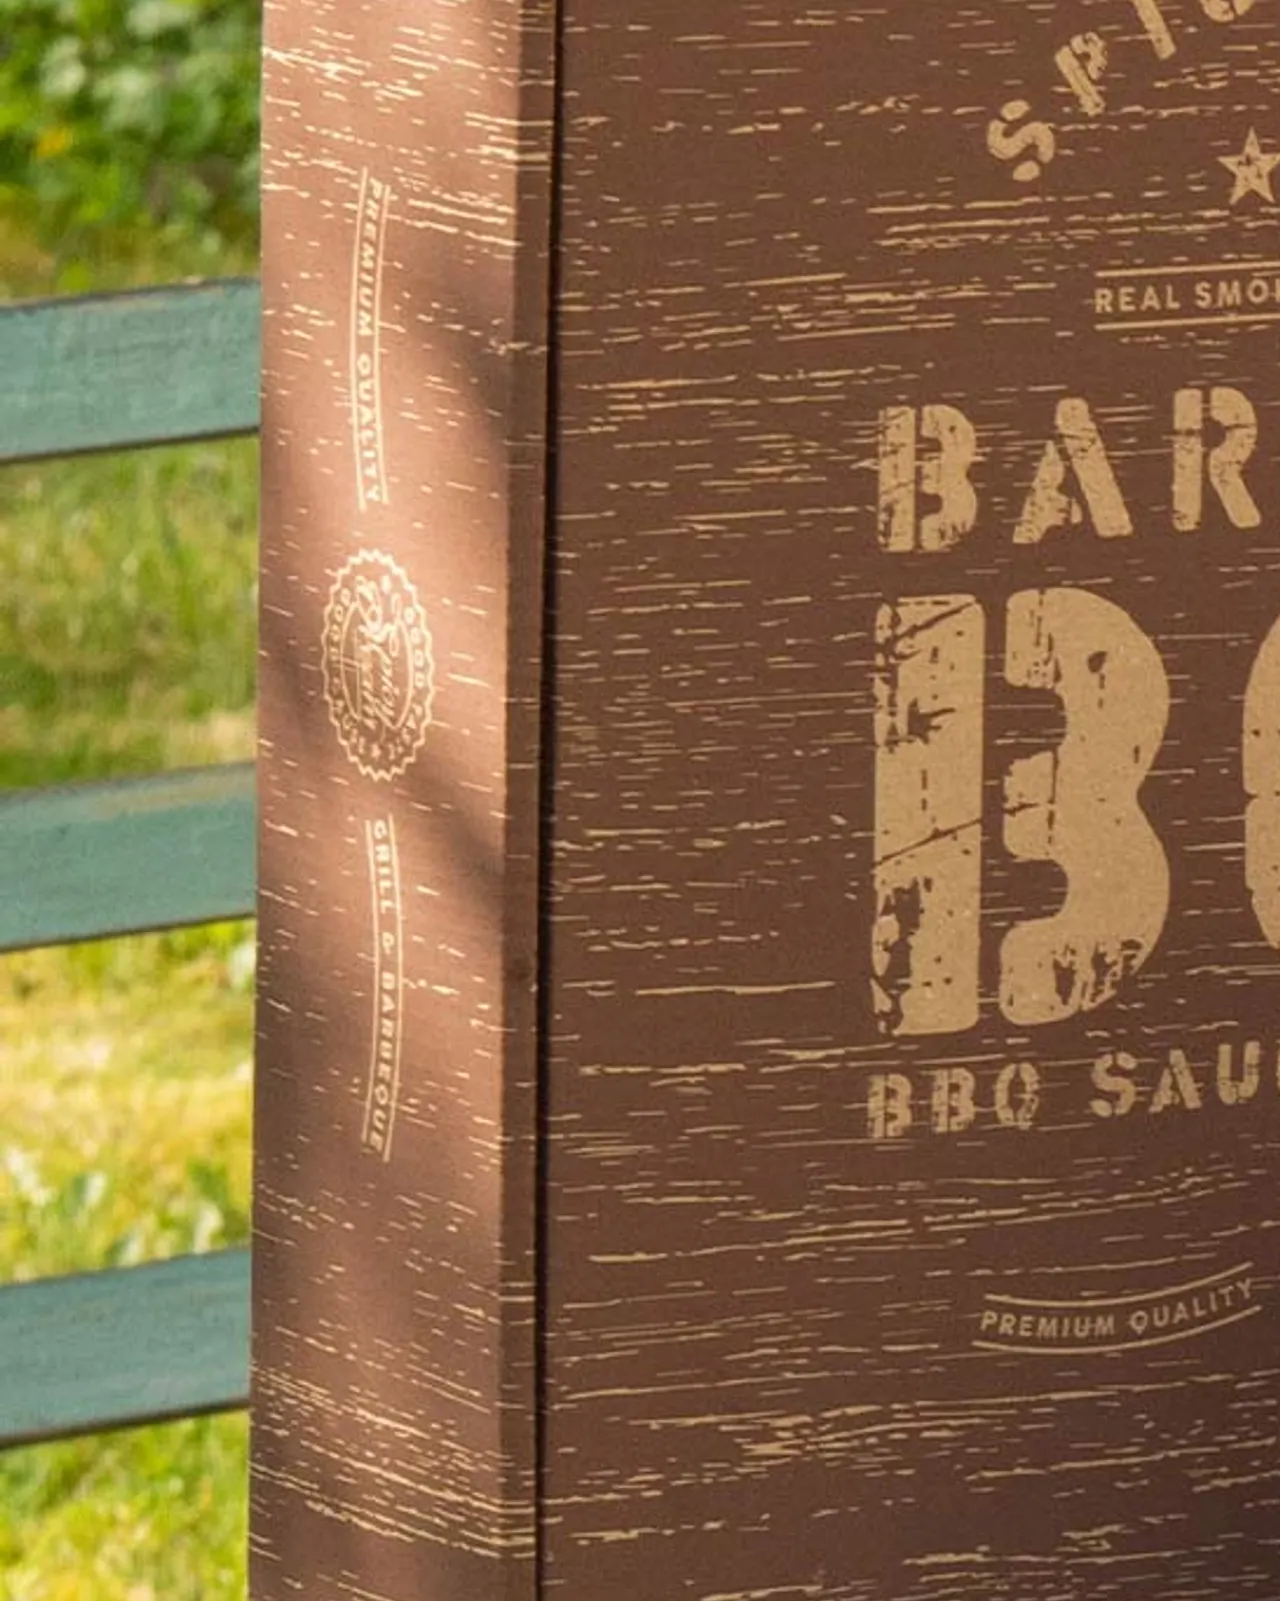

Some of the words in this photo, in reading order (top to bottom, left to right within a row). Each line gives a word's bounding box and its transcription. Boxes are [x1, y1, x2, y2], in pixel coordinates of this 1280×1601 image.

[357, 177, 384, 338] PREMIUM
[1095, 279, 1182, 315] REAL
[357, 354, 381, 504] QUALITY
[374, 819, 394, 915] GRILL
[370, 971, 397, 1155] BARBEQUE
[868, 1063, 1041, 1139] BBQ
[980, 1309, 1116, 1340] PREMIUM
[1128, 1277, 1257, 1334] QUALITY
